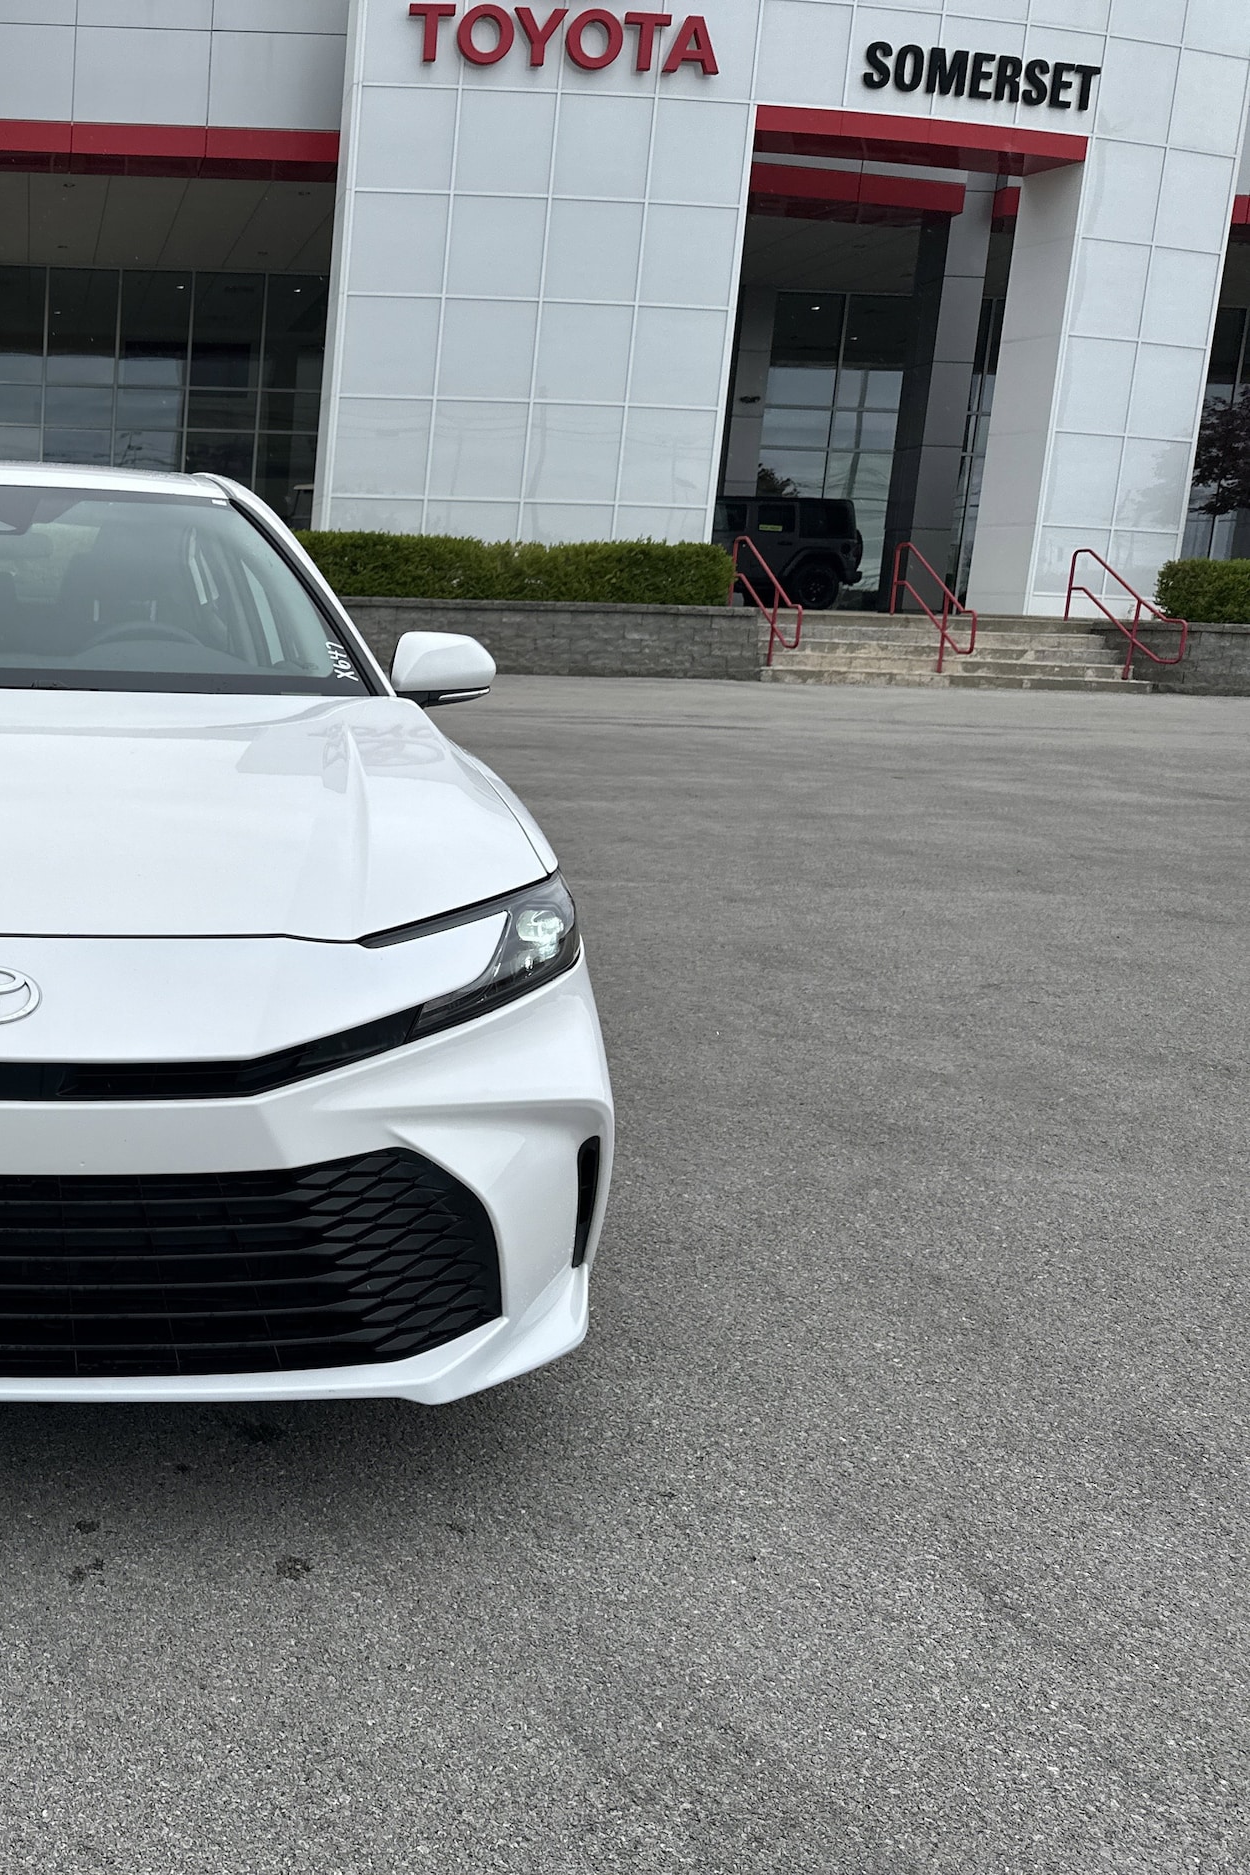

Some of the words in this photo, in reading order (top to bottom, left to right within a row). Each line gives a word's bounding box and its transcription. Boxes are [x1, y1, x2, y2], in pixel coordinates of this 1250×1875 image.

[409, 3, 719, 76] TOYOTA
[863, 40, 1102, 112] SOMERSET
[325, 640, 359, 682] X647
